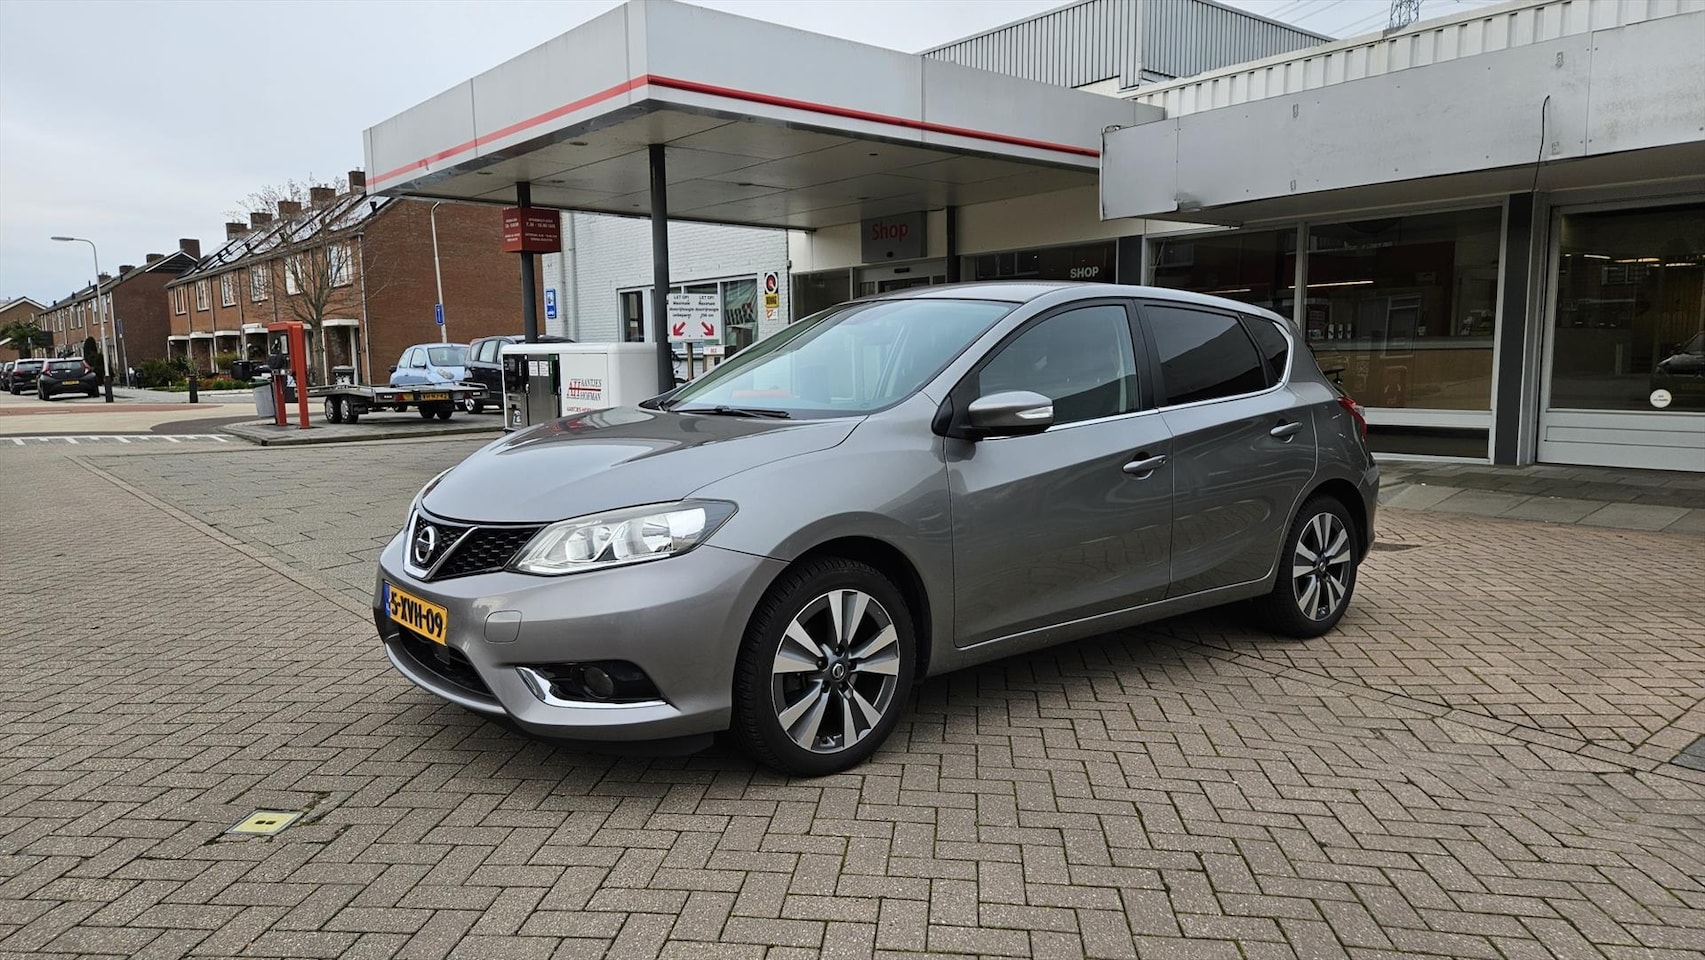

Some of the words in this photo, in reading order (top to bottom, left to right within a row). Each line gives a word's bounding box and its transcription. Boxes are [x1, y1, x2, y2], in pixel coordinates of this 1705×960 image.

[872, 221, 909, 242] Shop
[1070, 266, 1099, 279] SHOP
[390, 591, 443, 638] 5-XVH-09
